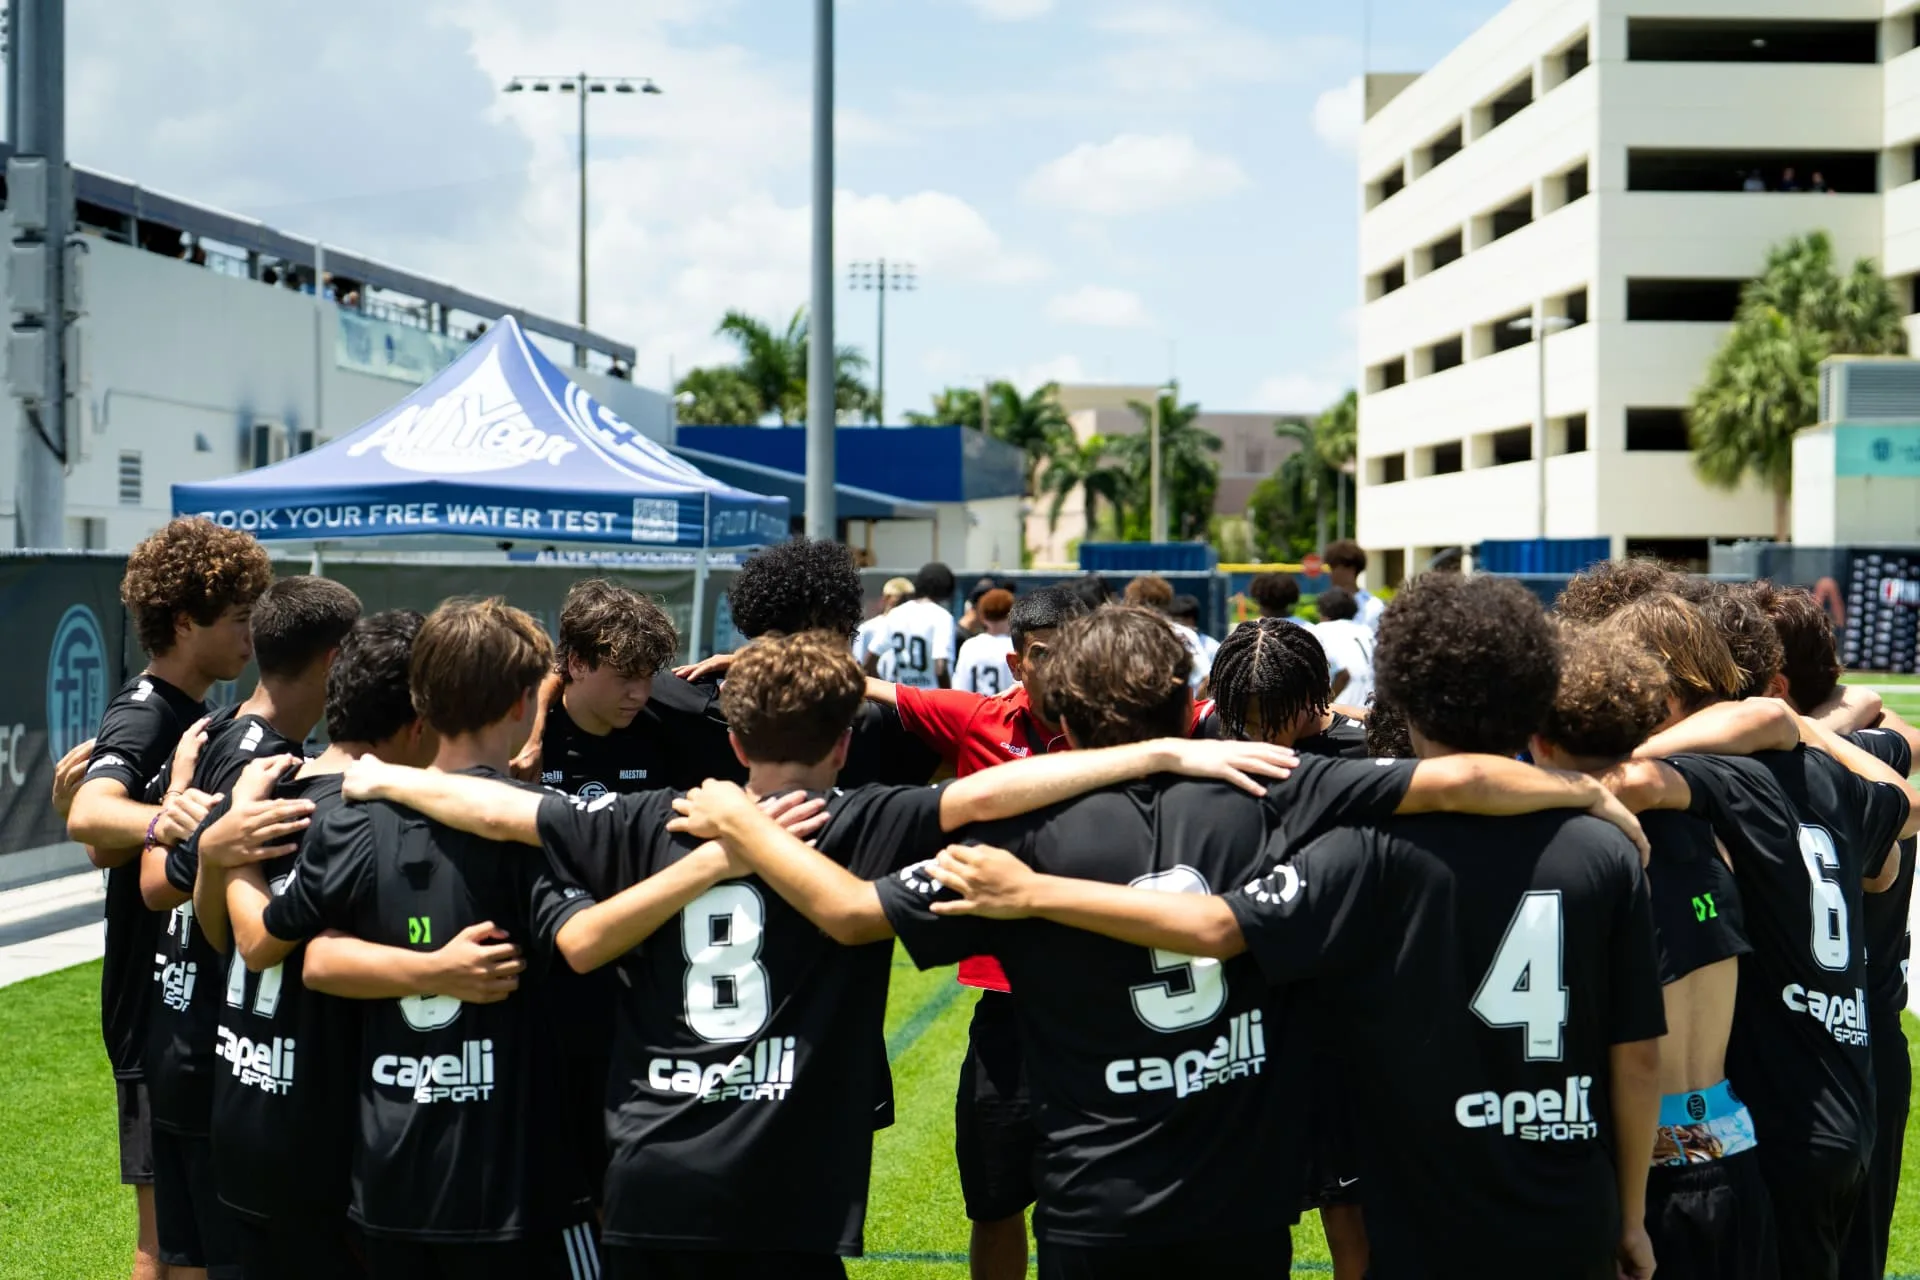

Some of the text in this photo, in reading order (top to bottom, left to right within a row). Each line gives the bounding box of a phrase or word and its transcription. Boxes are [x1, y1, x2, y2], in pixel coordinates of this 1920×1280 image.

[285, 506, 362, 529] YOUR
[368, 502, 439, 526] FREE
[446, 503, 541, 530] WATER
[546, 509, 618, 533] TEST
[891, 631, 927, 672] 20
[970, 665, 1000, 698] 13
[619, 769, 647, 779] MAESTRO
[1797, 823, 1850, 972] 6
[680, 881, 771, 1044] 8
[1468, 889, 1570, 1062] 4
[1782, 983, 1867, 1034] capelli
[1105, 1008, 1266, 1099] capelli
[1833, 1026, 1869, 1047] SPORT
[240, 1069, 294, 1096] SPORT
[372, 1038, 494, 1101] capelli
[648, 1036, 796, 1099] capelli
[1186, 1055, 1267, 1093] SPORT
[417, 1084, 495, 1104] SPORT
[702, 1082, 792, 1104] SPORT
[1519, 1122, 1598, 1142] SPORT
